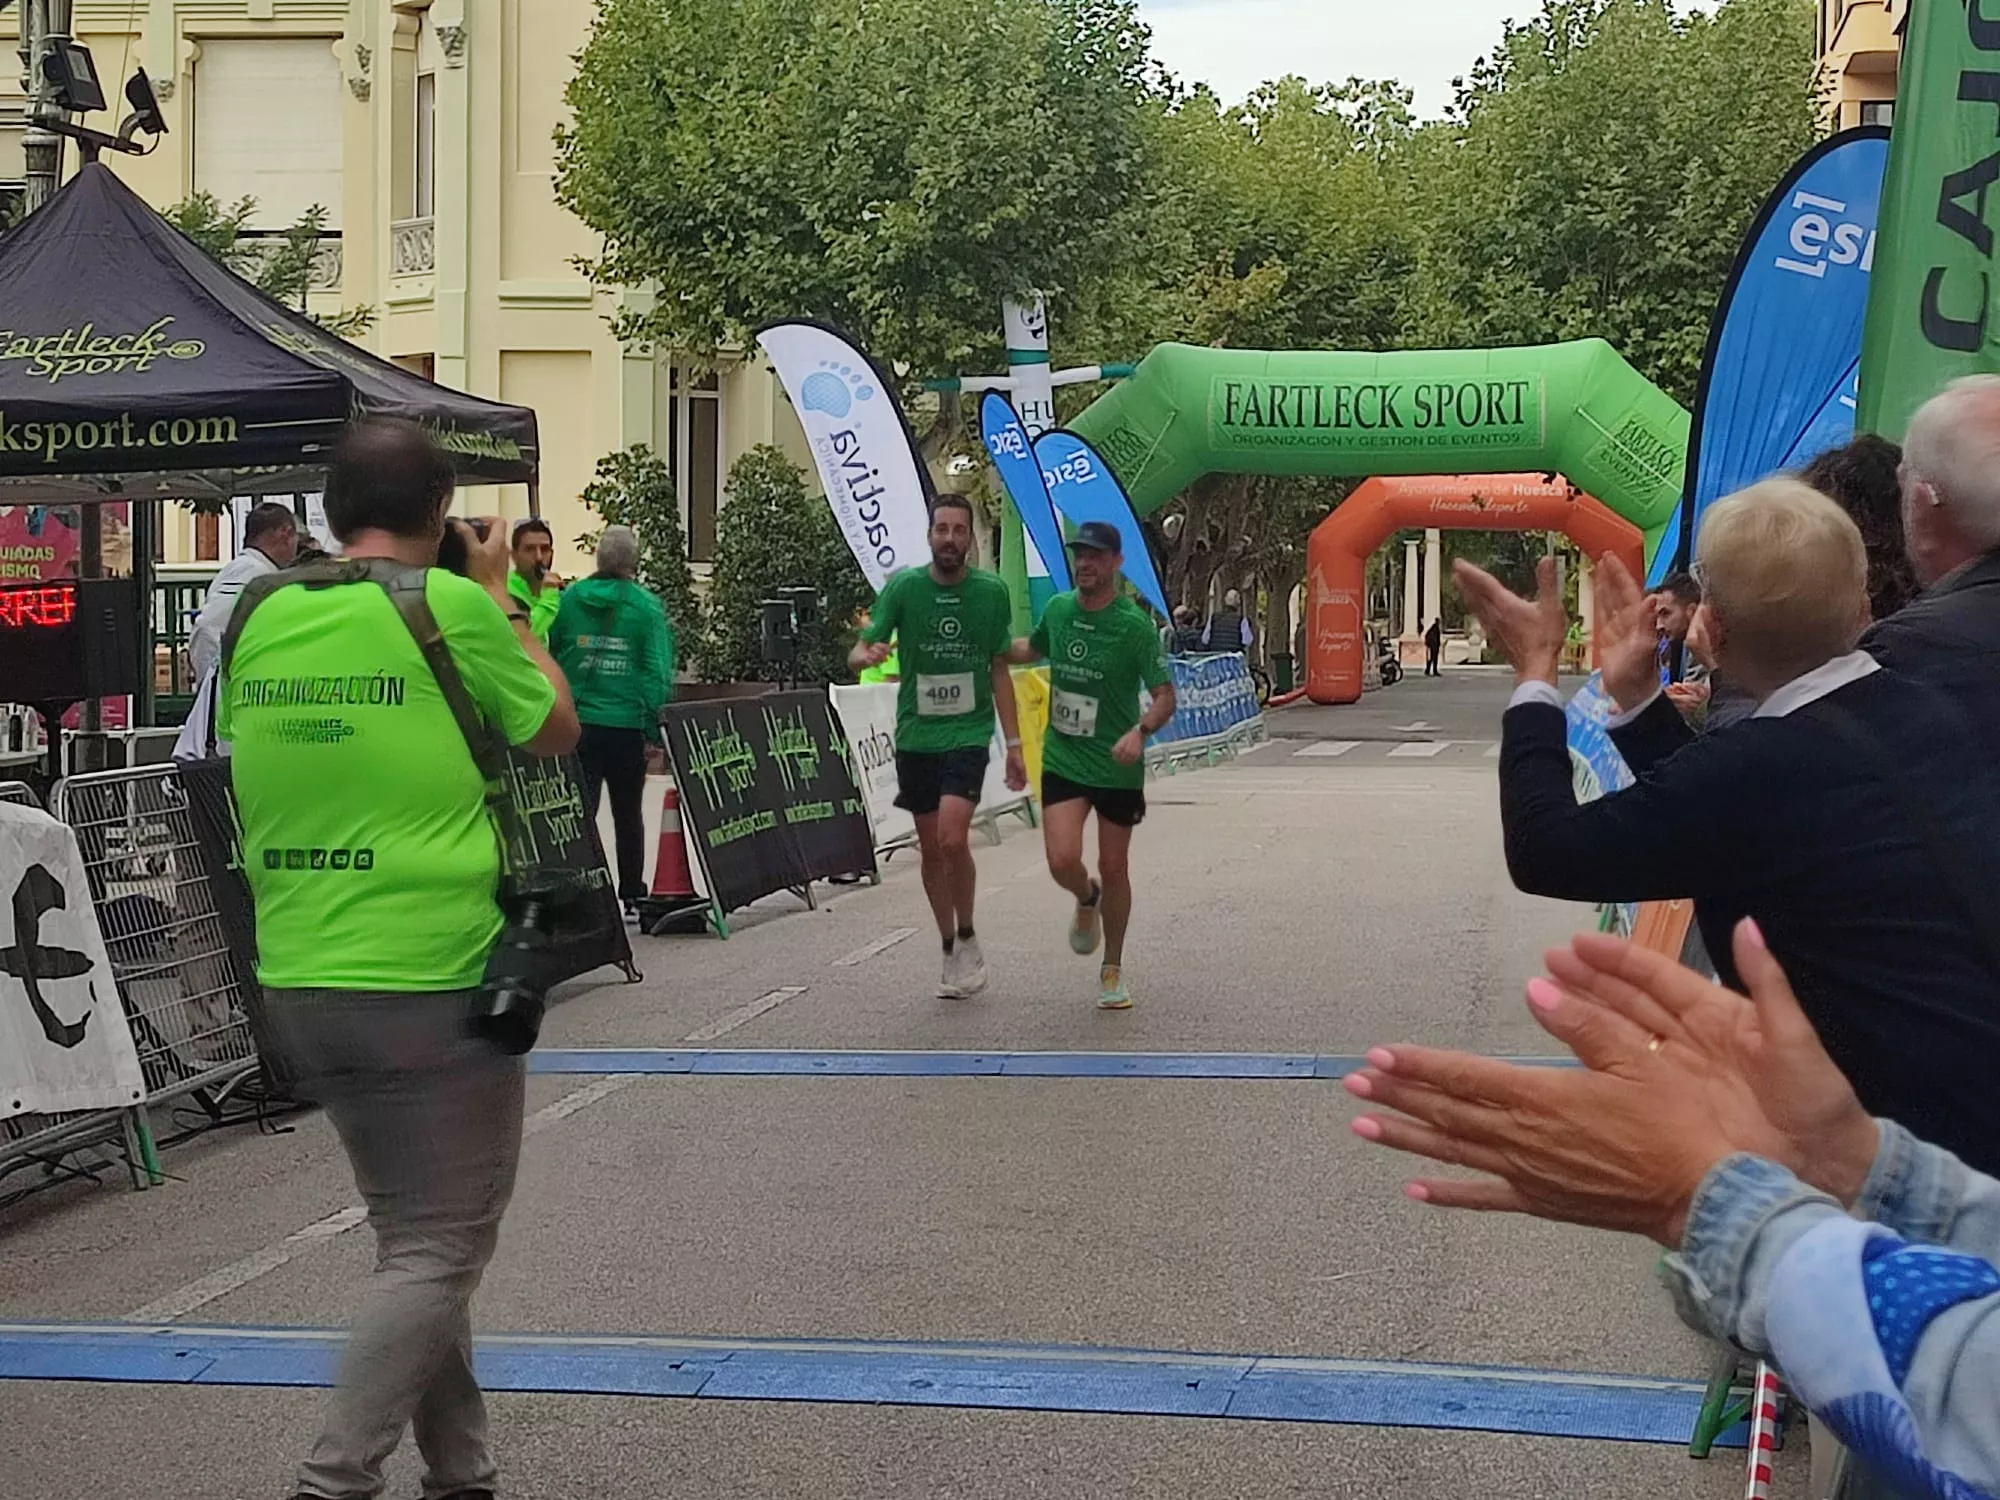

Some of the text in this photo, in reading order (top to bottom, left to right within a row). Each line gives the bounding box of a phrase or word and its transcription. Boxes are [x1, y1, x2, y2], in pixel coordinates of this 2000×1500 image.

[25, 346, 158, 384] Sport
[1222, 380, 1529, 429] FARTLECK SPORT
[1345, 434, 1354, 446] Y
[1427, 433, 1447, 446] DE
[1450, 431, 1521, 446] EVENTOS
[1513, 483, 1563, 497] Huesca
[0, 546, 55, 562] UIADAS
[0, 563, 41, 579] ISMO
[925, 684, 961, 701] 400
